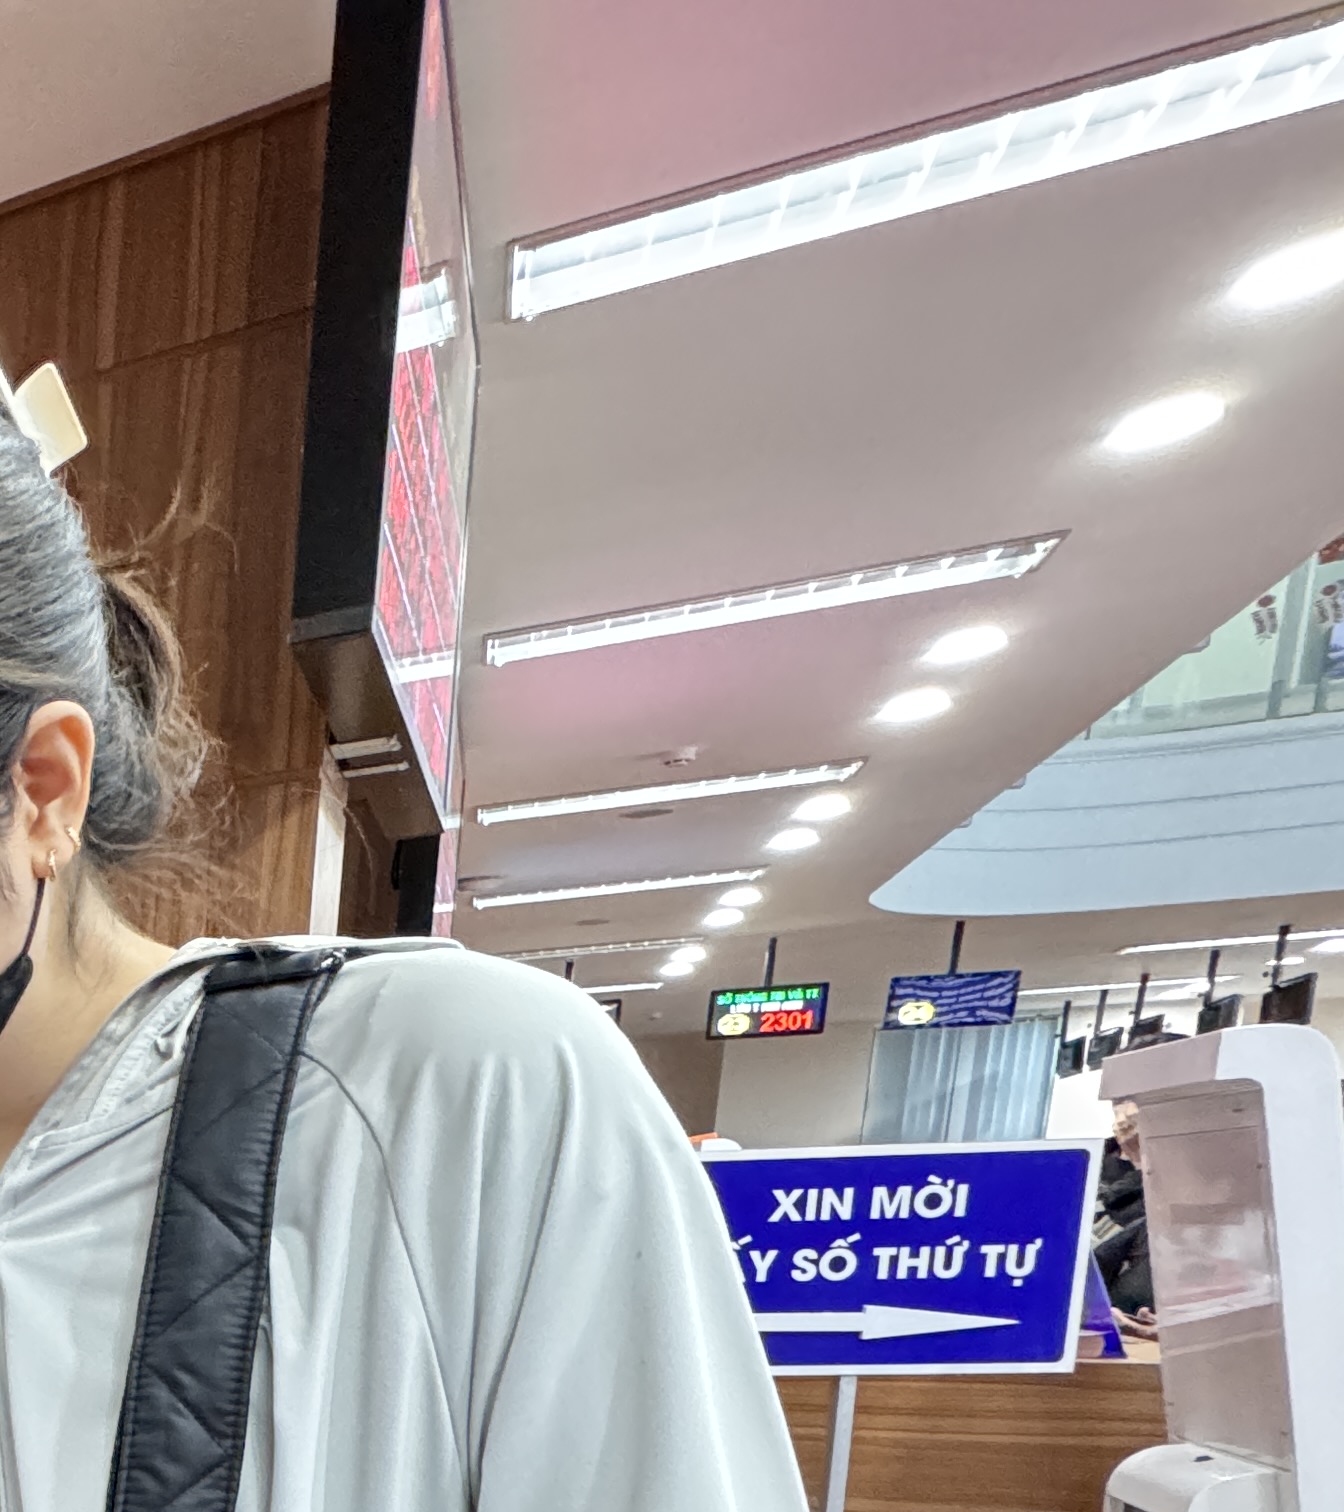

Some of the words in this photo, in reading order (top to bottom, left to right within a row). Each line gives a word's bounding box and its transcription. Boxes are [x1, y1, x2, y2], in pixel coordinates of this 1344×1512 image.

[759, 1010, 813, 1033] 2301
[767, 1187, 854, 1223] XIN
[869, 1174, 970, 1220] MỜI
[790, 1232, 861, 1282] SỐ
[872, 1235, 970, 1281] THỨ
[980, 1238, 1042, 1287] TỰ
